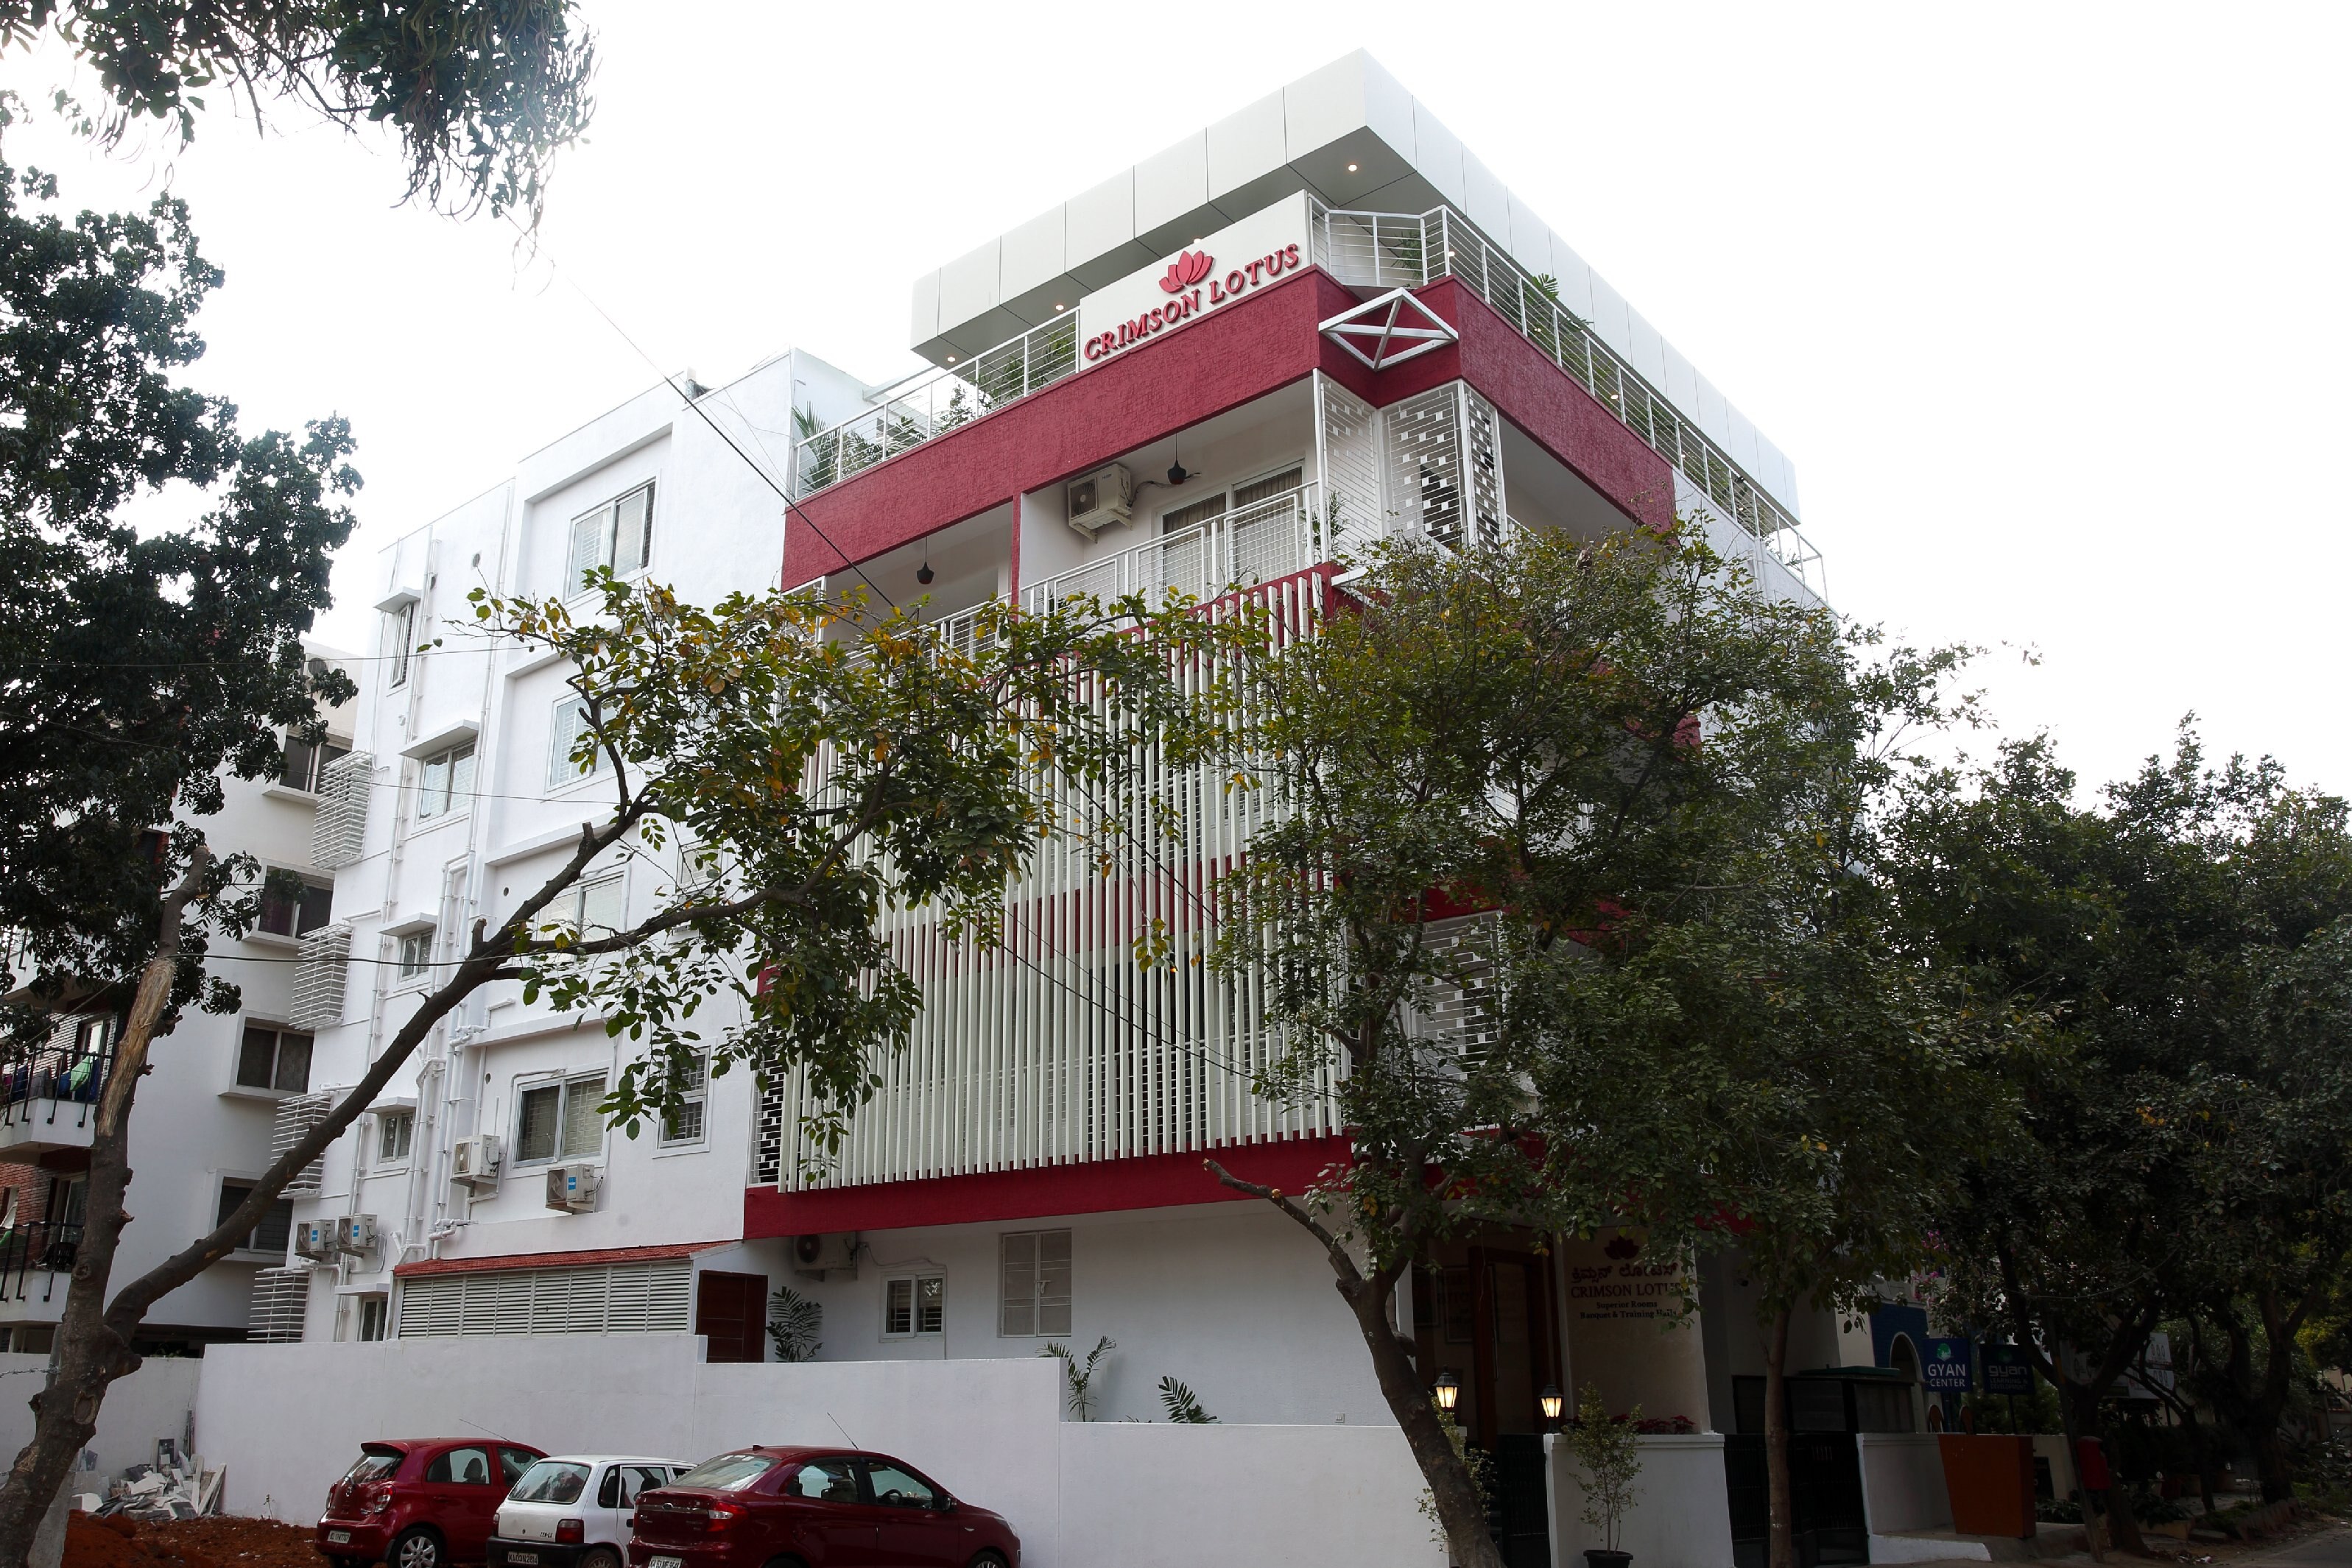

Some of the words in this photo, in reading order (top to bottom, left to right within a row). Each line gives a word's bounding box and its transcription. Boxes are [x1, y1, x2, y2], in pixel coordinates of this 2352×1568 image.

[1084, 288, 1200, 361] CRIMSON
[1209, 243, 1300, 303] LOTUS
[1571, 1284, 1632, 1298] CRIMSON
[1596, 1302, 1629, 1310] Superior
[1619, 1310, 1655, 1319] Training
[1928, 1363, 1966, 1377] GYAN
[1988, 1365, 2027, 1377] gyan
[1930, 1378, 1965, 1387] CENTER
